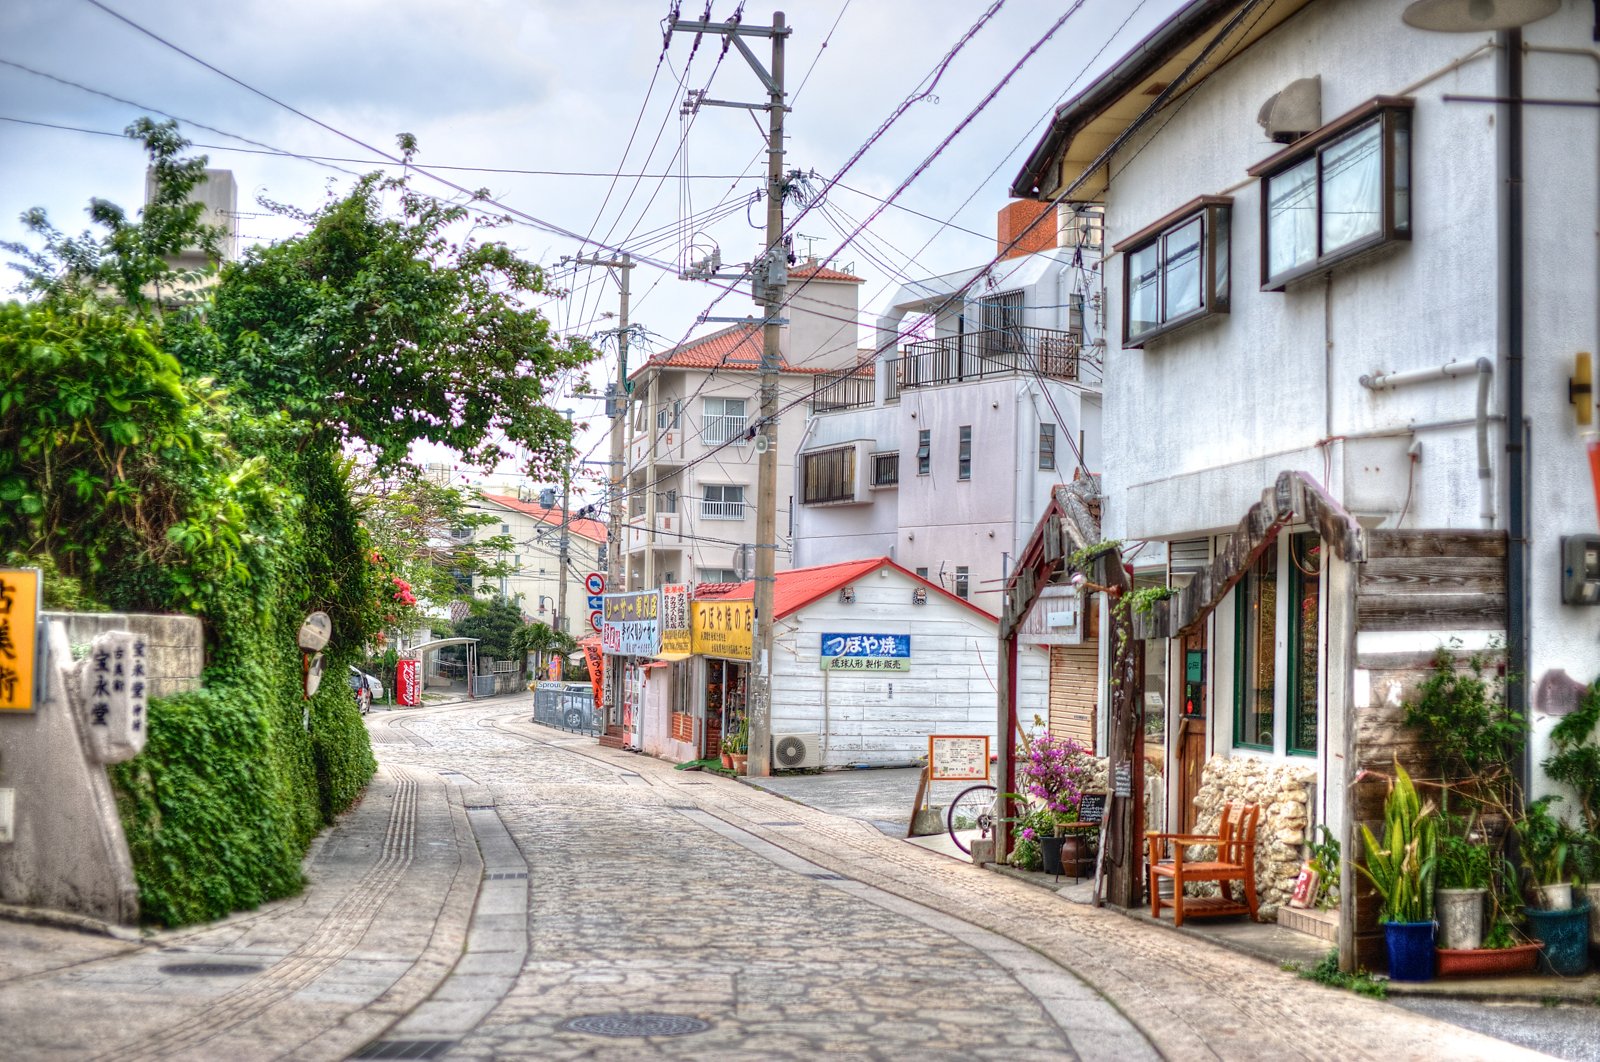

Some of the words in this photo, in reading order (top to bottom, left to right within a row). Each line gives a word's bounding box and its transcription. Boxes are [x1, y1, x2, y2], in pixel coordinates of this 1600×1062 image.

[699, 604, 752, 632] つぼや焼の店
[827, 635, 897, 654] つぼや焼
[831, 658, 864, 669] 琉球人形
[91, 650, 110, 726] 宝永堂
